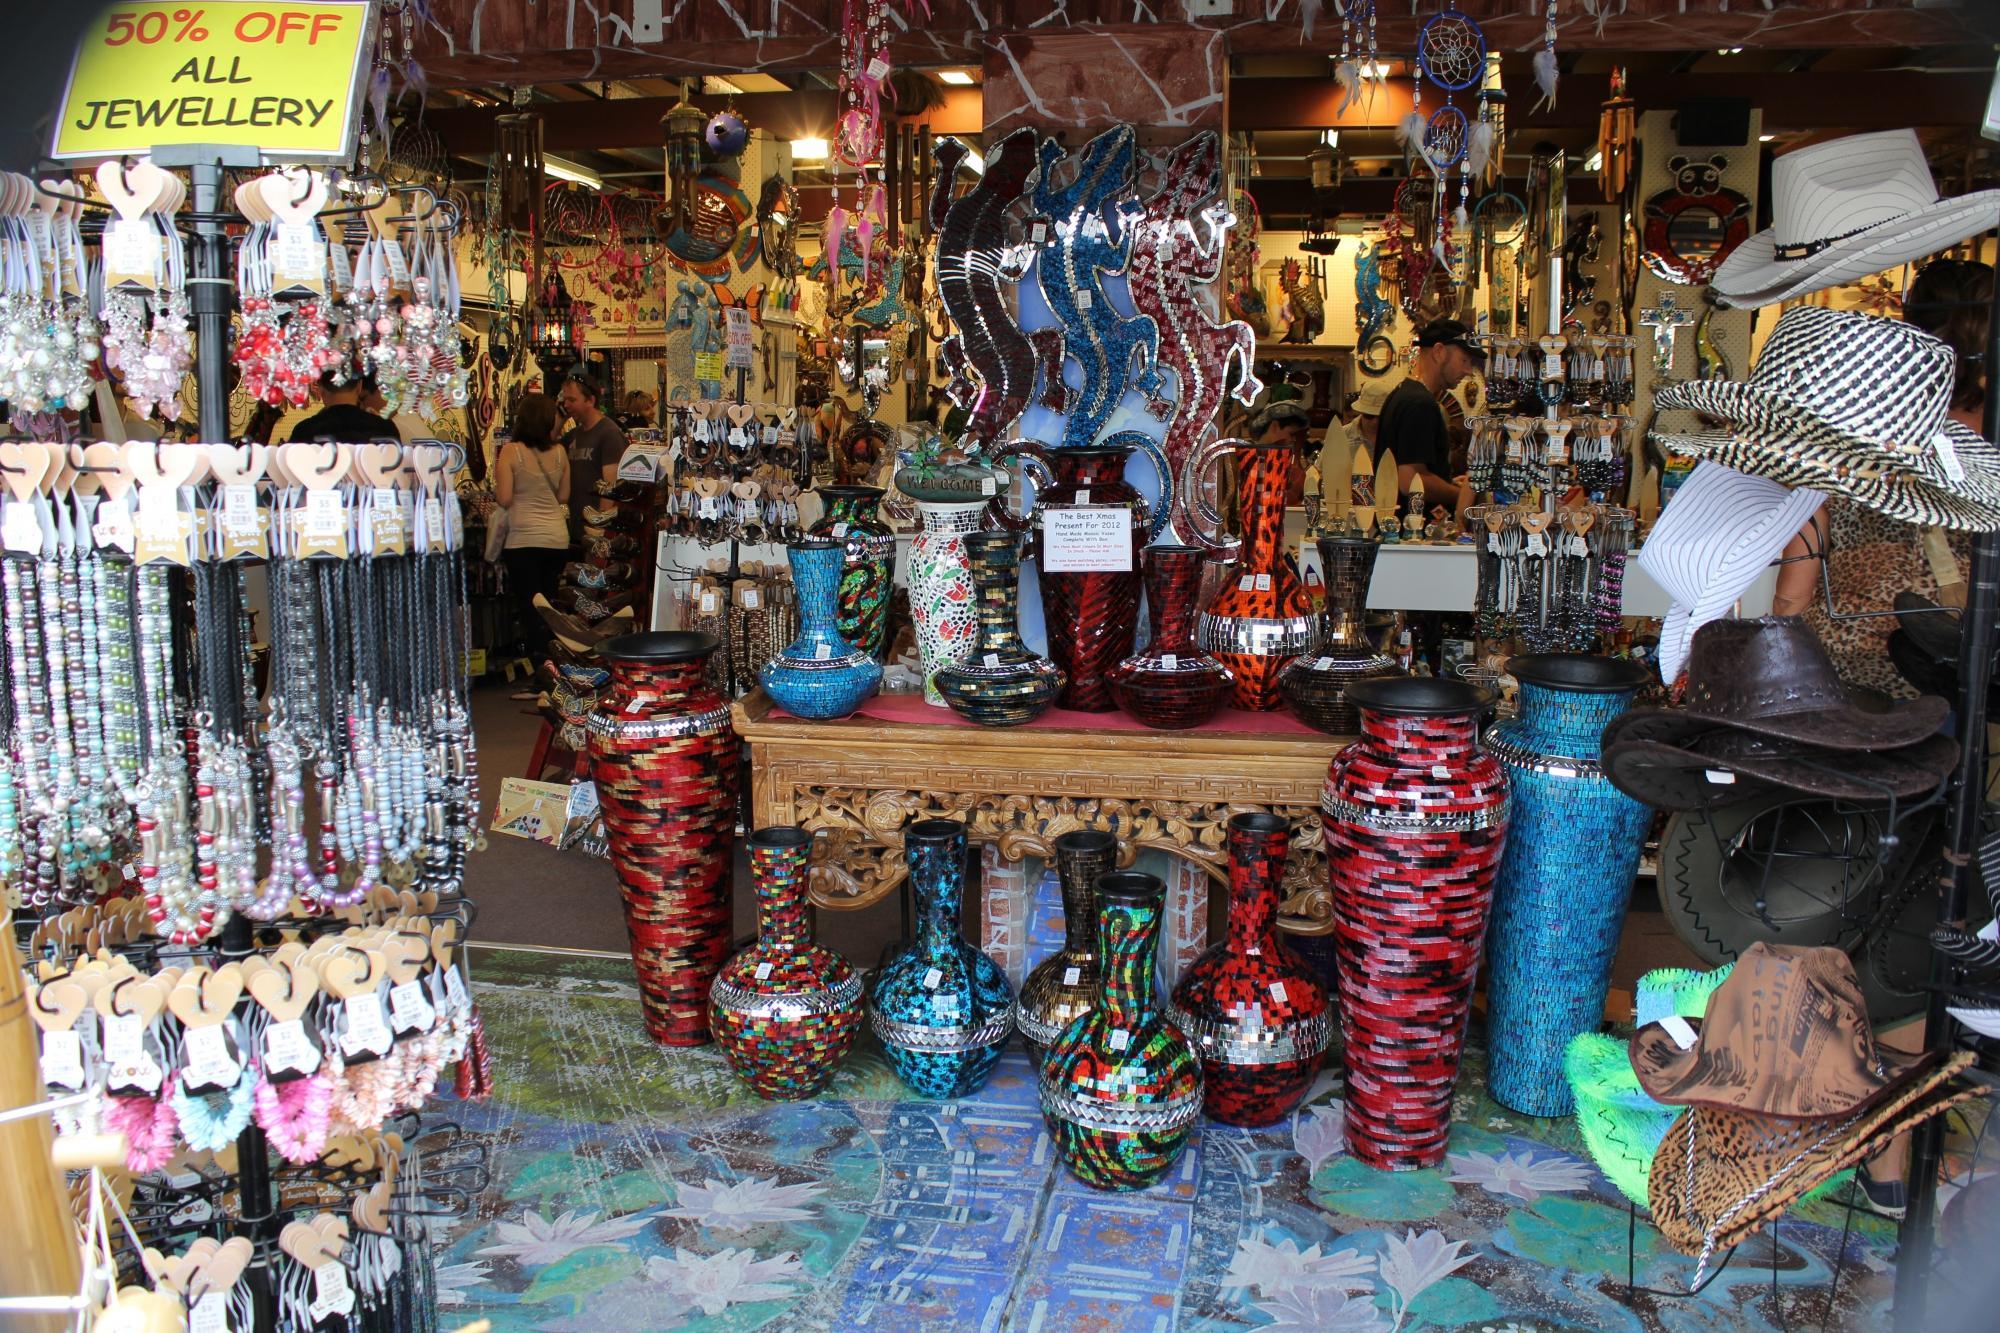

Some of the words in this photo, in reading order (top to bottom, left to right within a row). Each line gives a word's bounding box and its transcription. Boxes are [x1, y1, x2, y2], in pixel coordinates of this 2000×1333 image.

[104, 9, 209, 46] 50%
[234, 11, 343, 45] OFF
[171, 55, 252, 84] ALL
[76, 96, 334, 130] JEWELLERY
[1101, 521, 1121, 529] 2012
